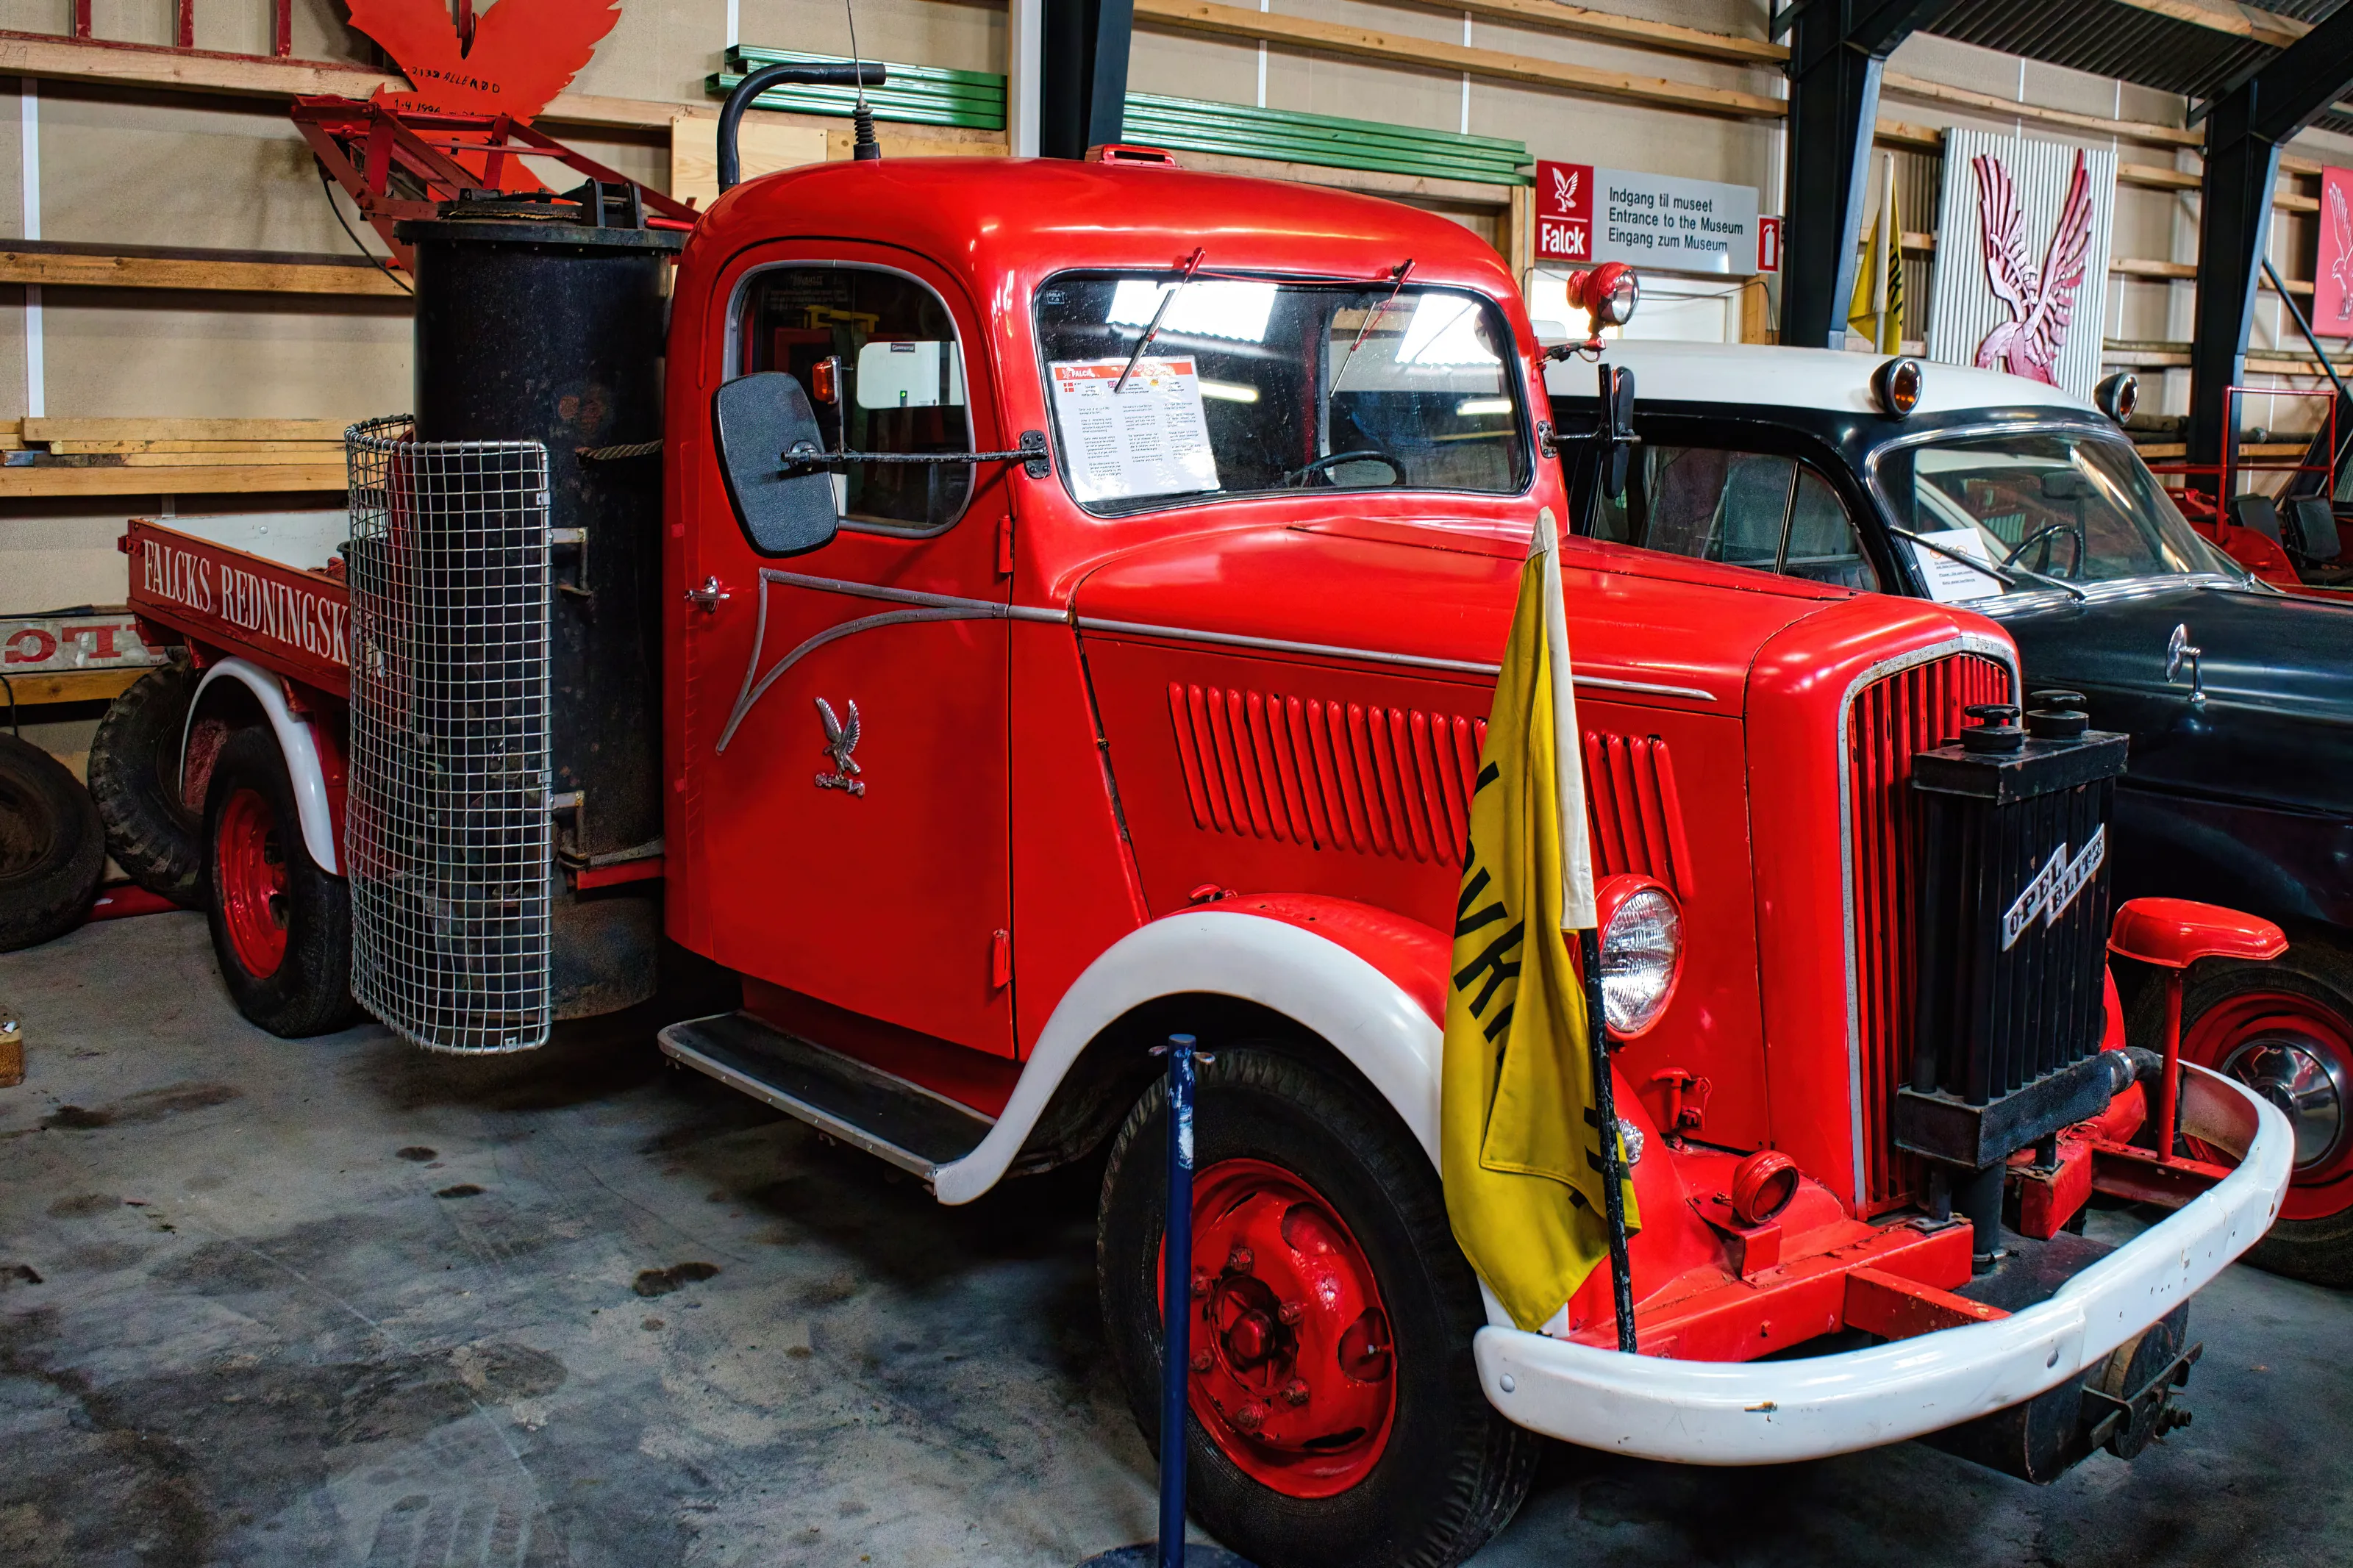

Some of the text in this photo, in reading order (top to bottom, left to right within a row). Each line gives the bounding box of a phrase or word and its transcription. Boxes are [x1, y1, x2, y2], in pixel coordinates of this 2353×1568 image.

[1609, 186, 1713, 212] Indgang til museet
[1609, 208, 1743, 235] Entrance to the Museum
[1541, 223, 1585, 255] Falck
[1608, 227, 1728, 252] Eingang zum Museum
[143, 539, 212, 612] FALCKS
[2052, 834, 2102, 914] BLITZ
[2010, 859, 2062, 937] OPEL
